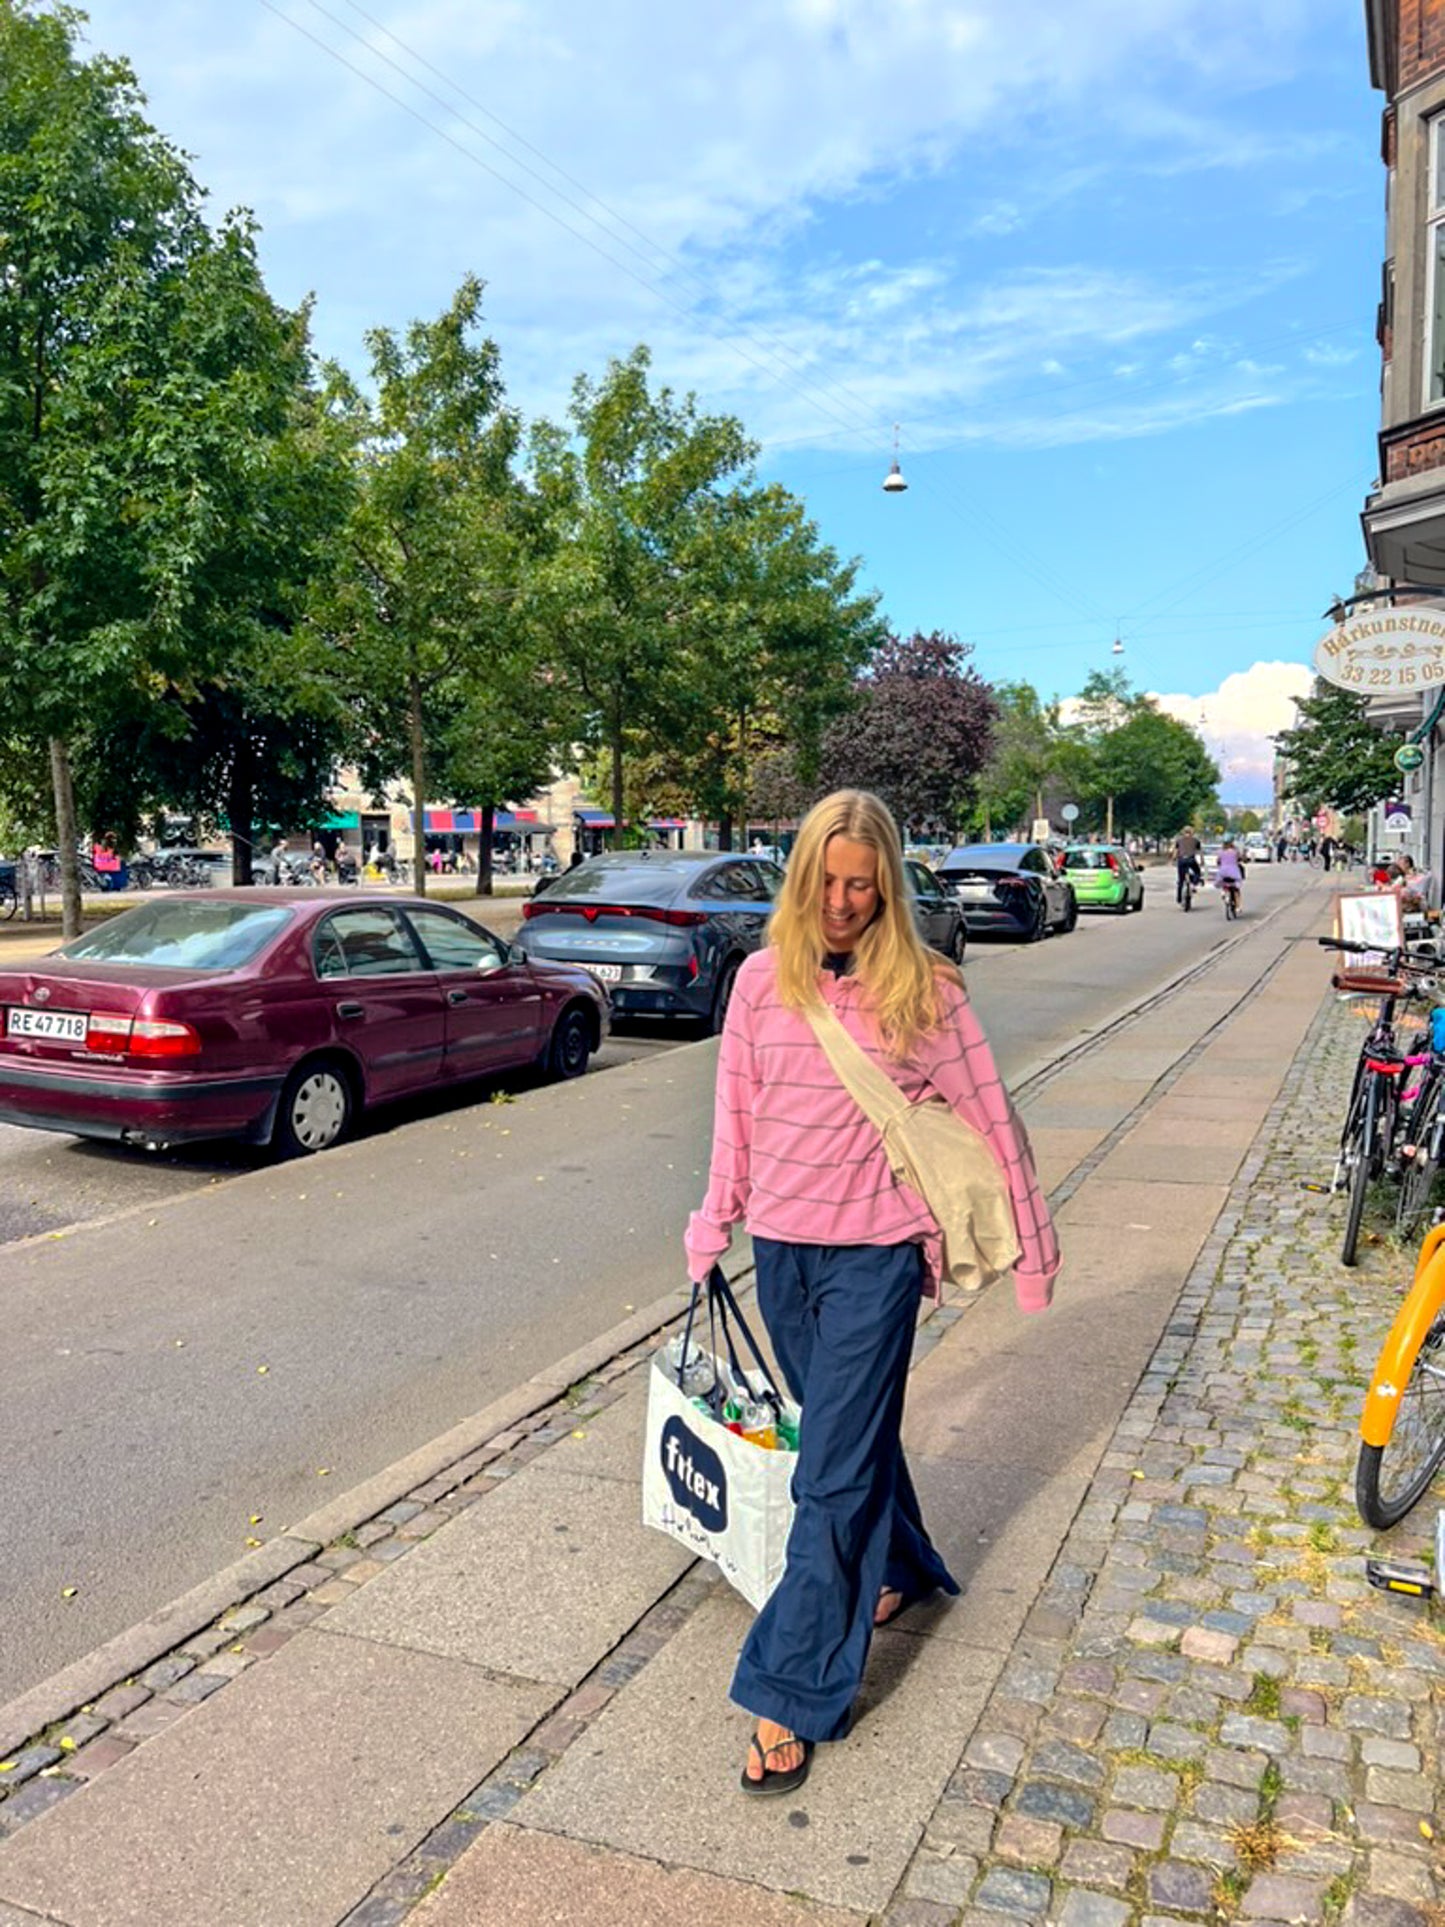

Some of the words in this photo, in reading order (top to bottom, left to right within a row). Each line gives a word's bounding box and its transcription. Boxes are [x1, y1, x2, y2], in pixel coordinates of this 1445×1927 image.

[1341, 665, 1364, 682] 33
[1368, 668, 1391, 685] 22
[1398, 666, 1416, 684] 15
[1422, 661, 1444, 681] 05
[11, 1012, 33, 1032] RE
